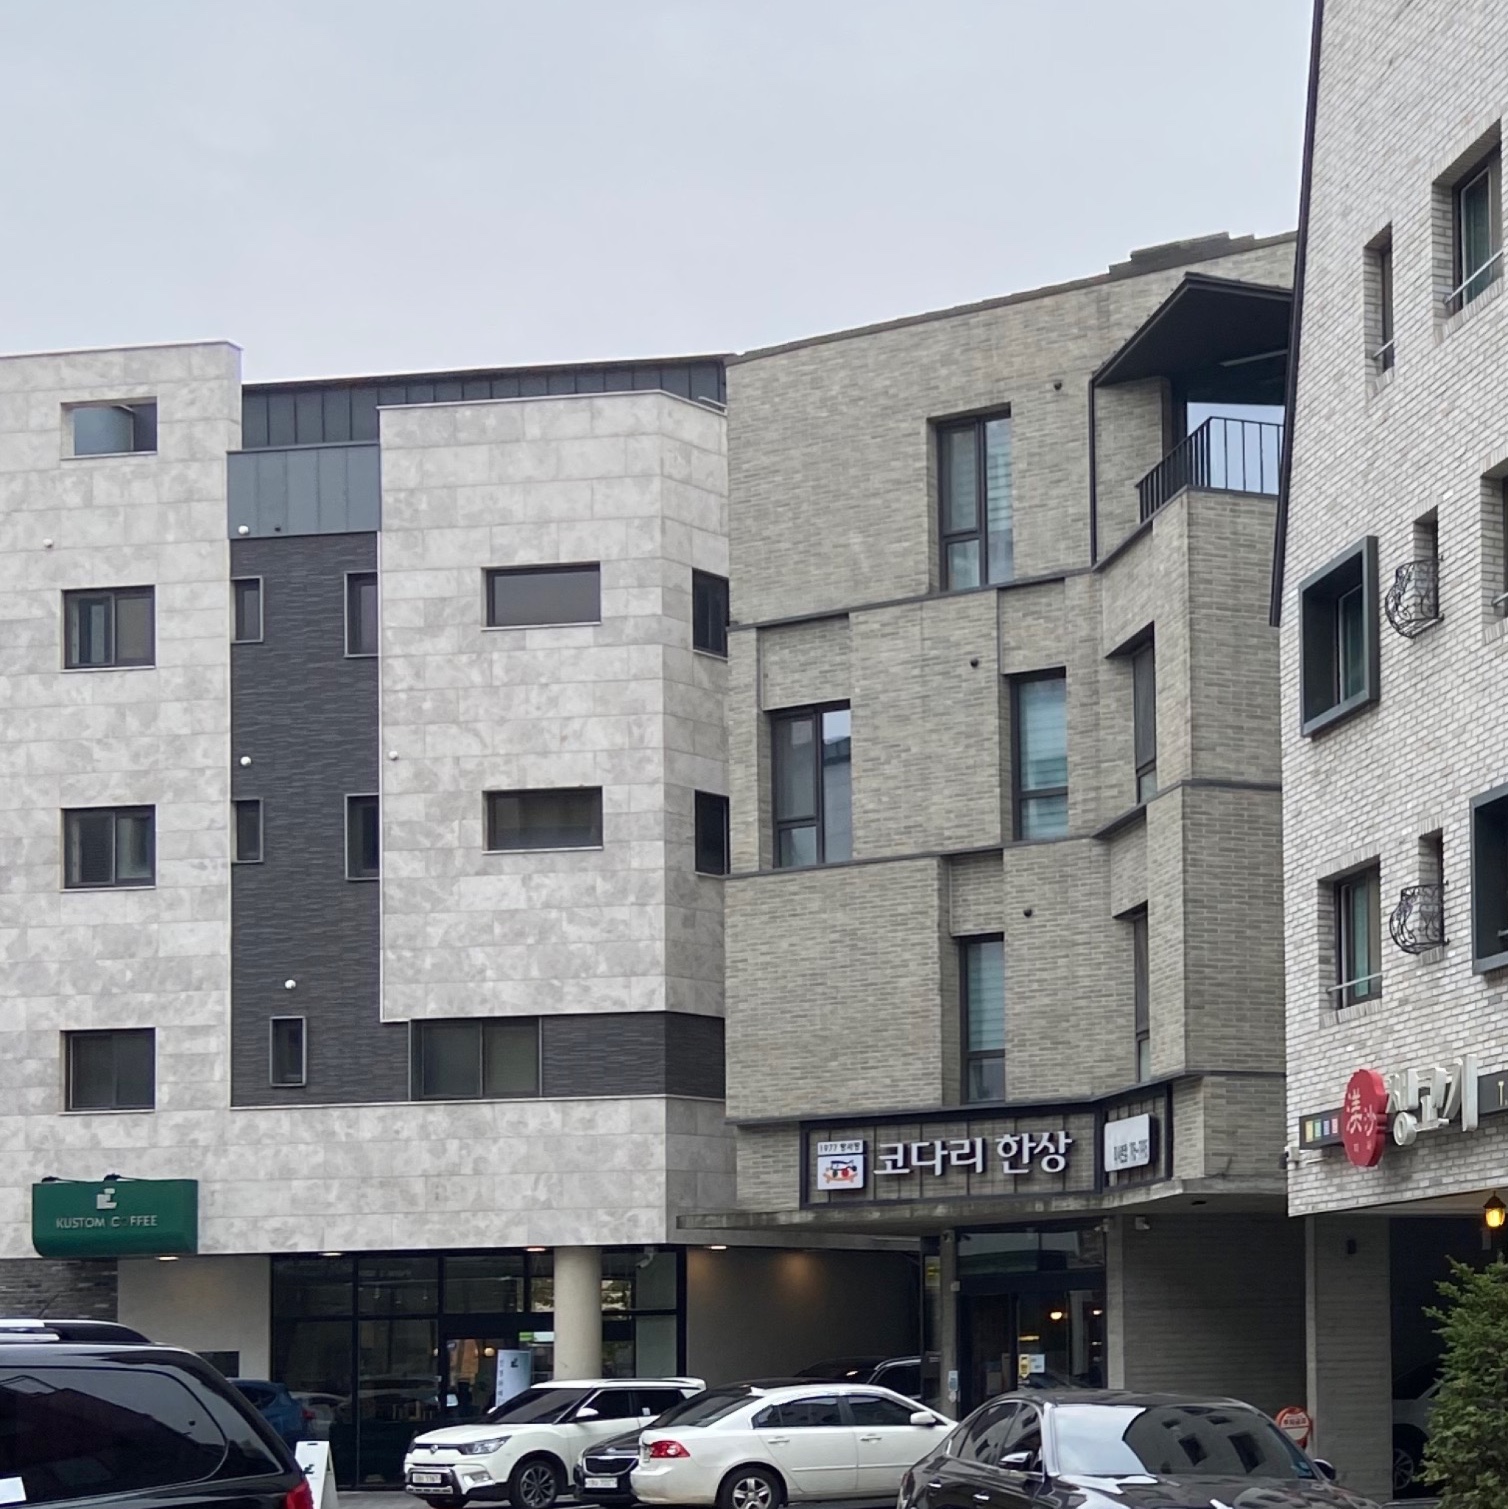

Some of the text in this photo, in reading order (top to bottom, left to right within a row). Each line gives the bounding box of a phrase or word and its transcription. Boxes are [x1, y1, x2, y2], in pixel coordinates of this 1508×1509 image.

[874, 1137, 983, 1176] 코다리
[995, 1131, 1073, 1174] 한상
[56, 1217, 105, 1229] KUSTOM
